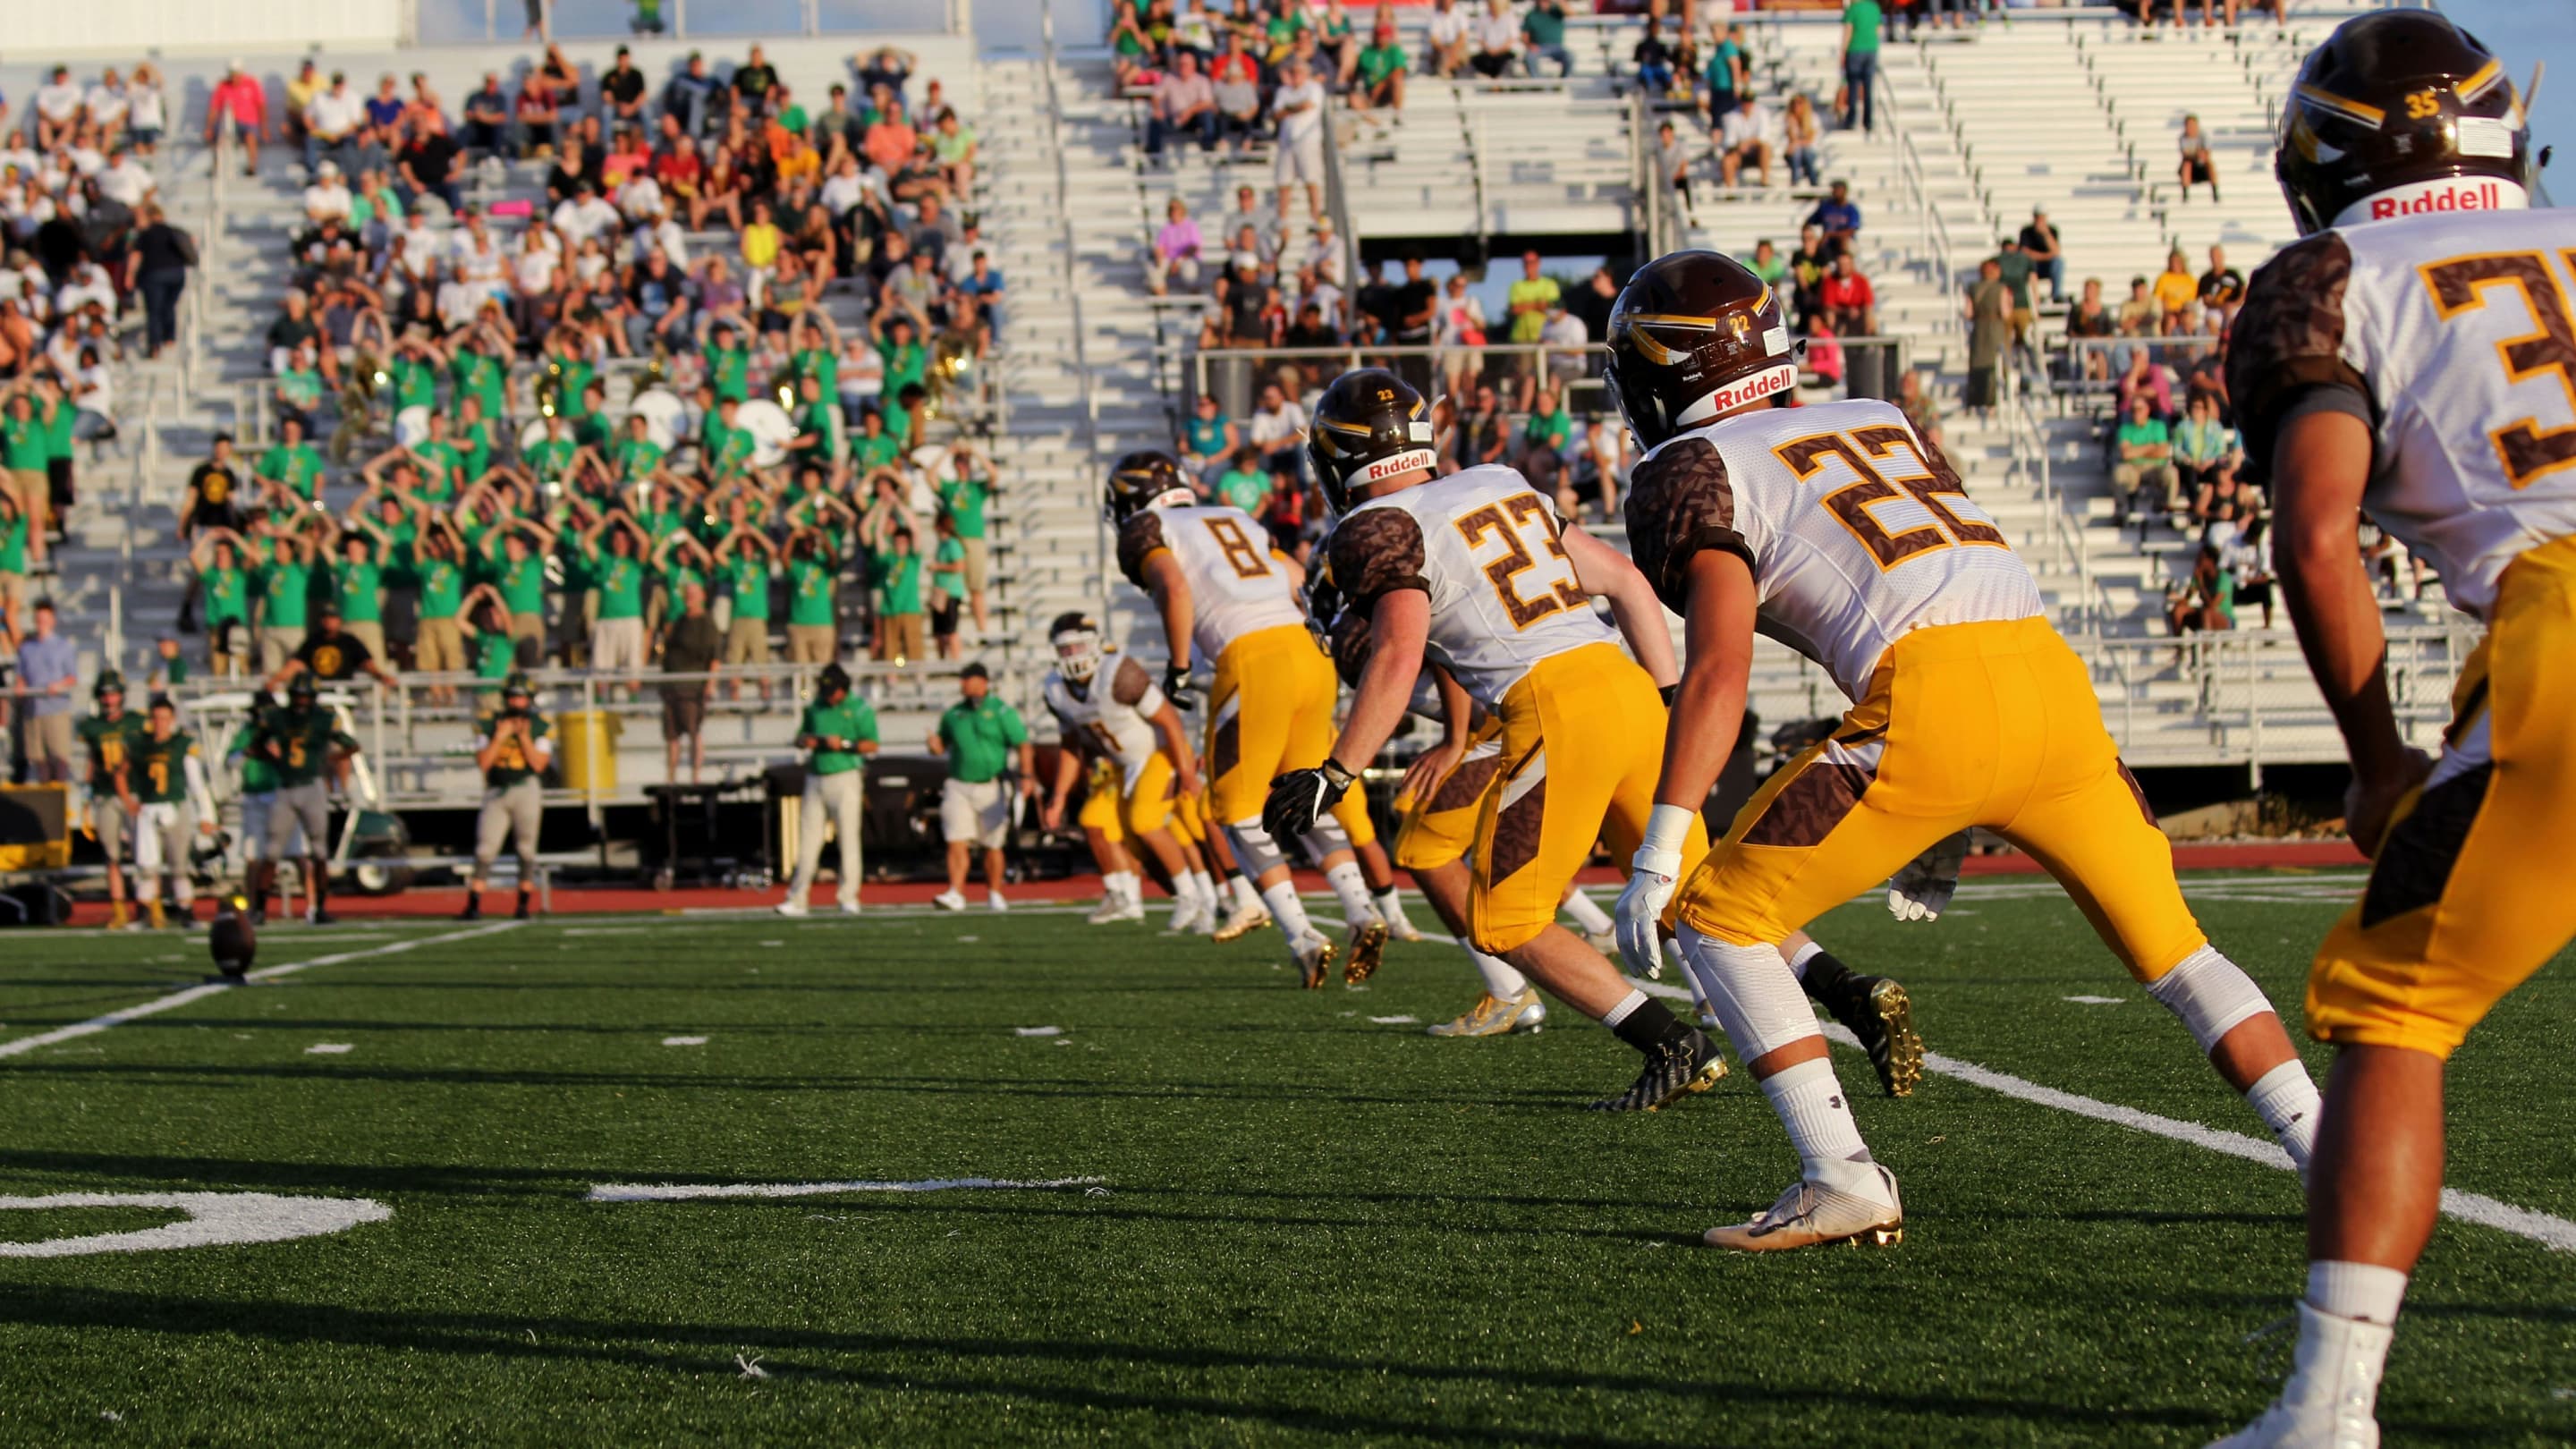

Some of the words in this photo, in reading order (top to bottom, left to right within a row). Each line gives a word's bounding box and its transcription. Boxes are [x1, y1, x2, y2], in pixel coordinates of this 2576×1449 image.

[2404, 91, 2440, 119] 35
[2372, 183, 2500, 220] Riddell
[1729, 315, 1750, 336] 22
[2417, 247, 2576, 490] 3
[1377, 389, 1394, 402] 23
[1714, 369, 1791, 411] Riddell
[1368, 453, 1429, 479] Riddell
[1770, 424, 2012, 574] 22
[1202, 516, 1273, 580] 8
[1453, 491, 1590, 632] 23
